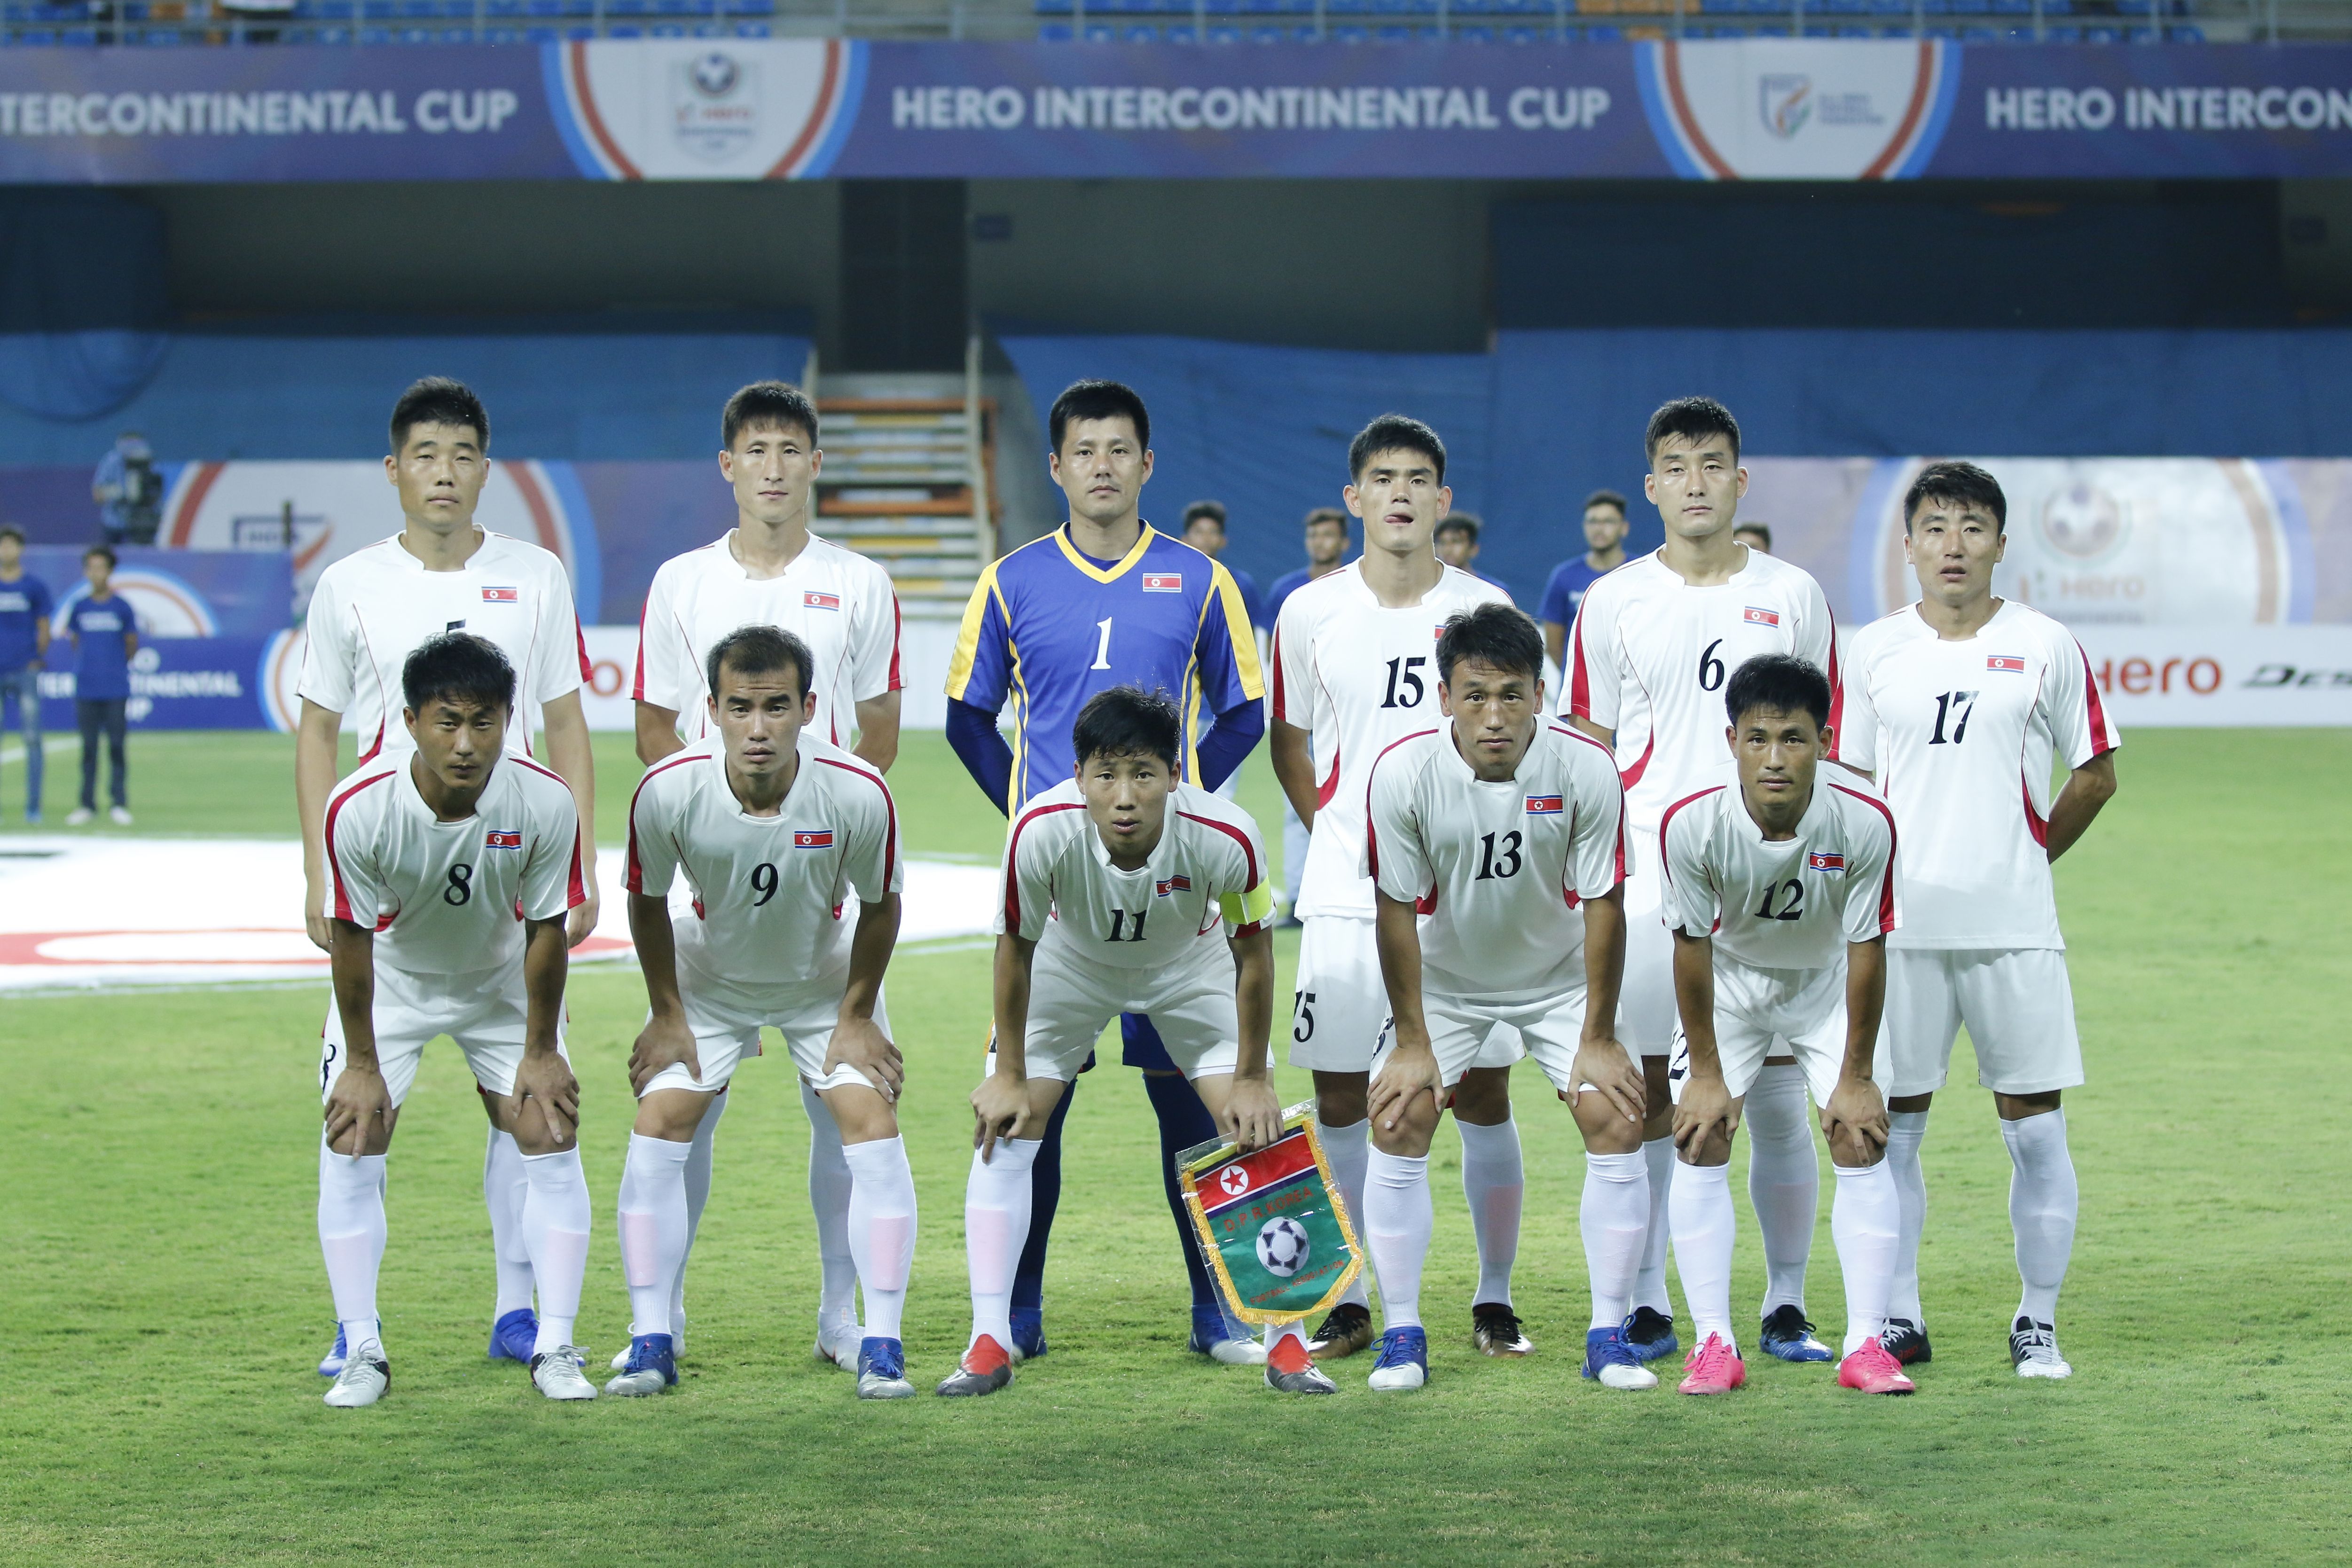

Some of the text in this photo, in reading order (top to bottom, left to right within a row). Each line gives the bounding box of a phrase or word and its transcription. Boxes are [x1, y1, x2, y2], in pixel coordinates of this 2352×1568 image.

[415, 89, 518, 133] CUP
[892, 86, 1612, 130] HERO INTERCONTINENTAL CUP
[1985, 86, 2352, 131] HERO INTERCON
[1090, 616, 1113, 670] 1
[1699, 639, 1725, 691] 6
[1380, 656, 1426, 708] 15
[1929, 690, 1979, 744] 17
[1475, 831, 1522, 880] 13
[444, 863, 472, 906] 8
[751, 863, 778, 906] 9
[1754, 878, 1804, 920] 12
[1104, 909, 1147, 942] 11
[1250, 1260, 1344, 1304] FOOTBALL ASSOCIATION
